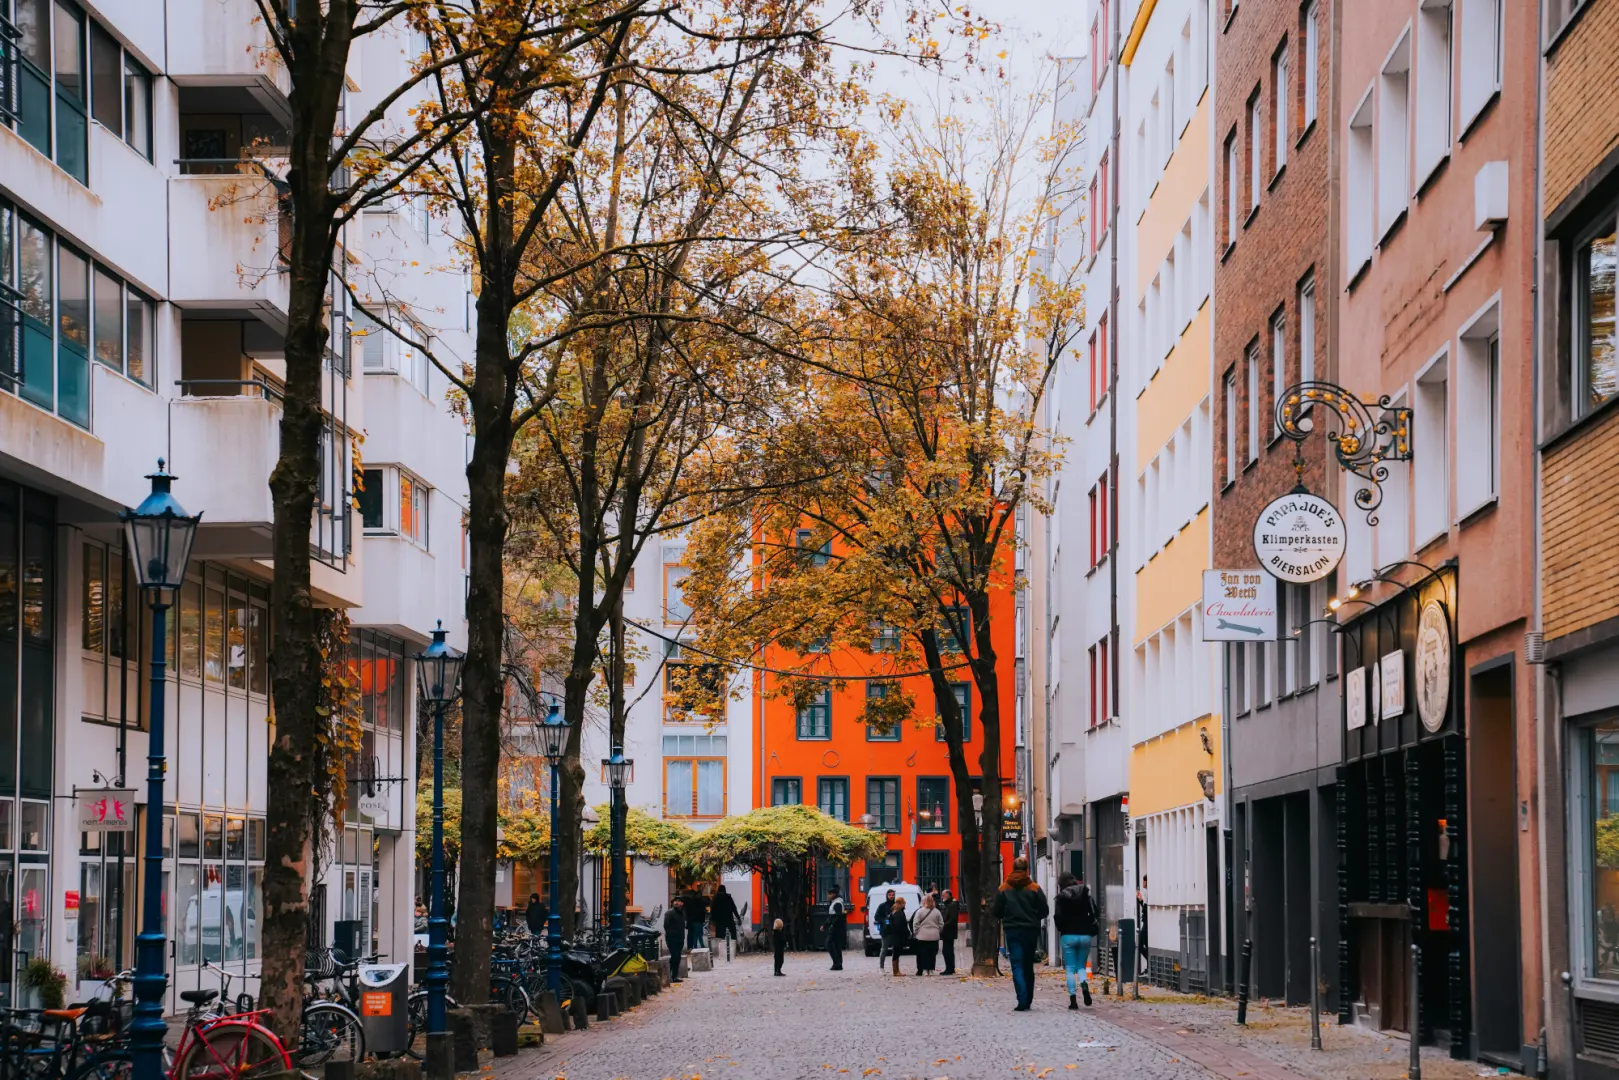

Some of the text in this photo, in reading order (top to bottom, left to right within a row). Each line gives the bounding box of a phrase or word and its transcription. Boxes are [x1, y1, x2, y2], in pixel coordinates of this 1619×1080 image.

[1266, 501, 1336, 528] PAPA JOE'S
[1262, 534, 1339, 546] Klimperkasten
[1270, 554, 1331, 577] BIERSALON
[1220, 572, 1261, 587] Jan von
[1224, 585, 1257, 600] Werth
[1205, 601, 1275, 617] Chocolaterie
